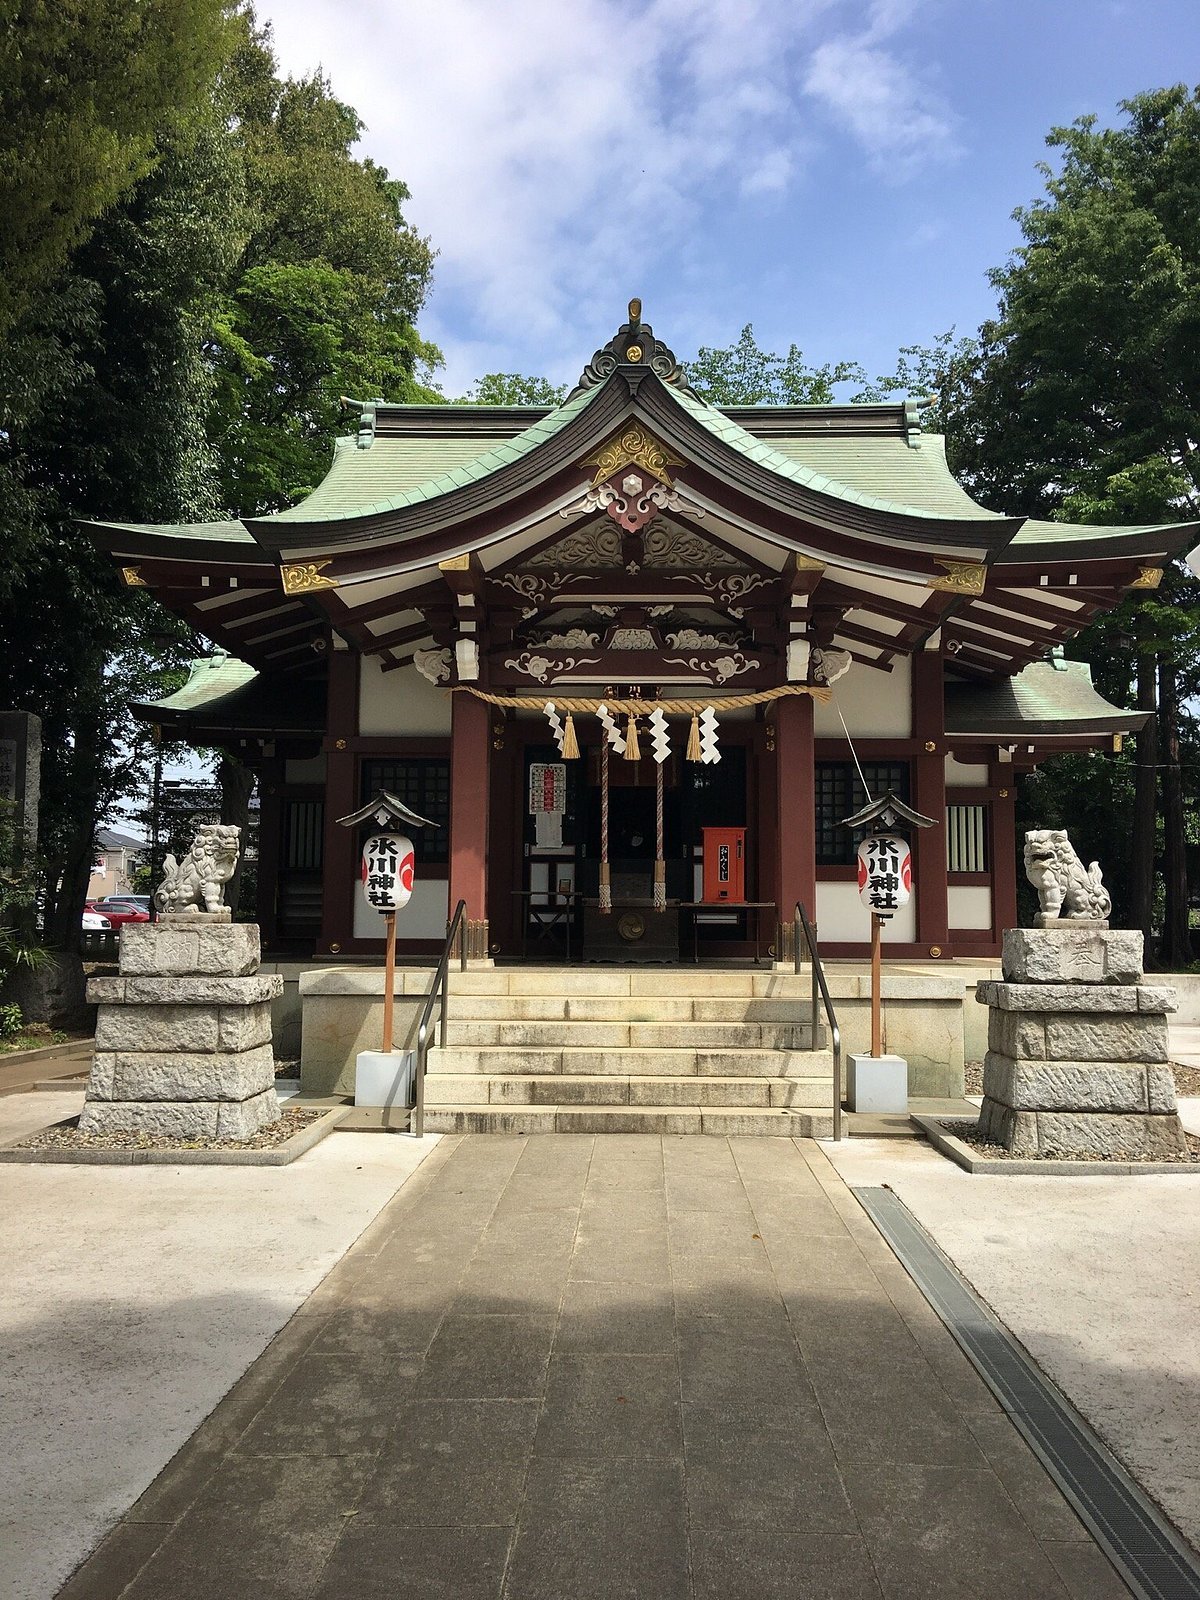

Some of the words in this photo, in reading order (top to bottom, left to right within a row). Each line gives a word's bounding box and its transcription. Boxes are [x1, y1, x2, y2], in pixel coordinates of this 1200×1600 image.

[368, 837, 398, 907] 氷川神社
[720, 846, 728, 881] おみくじ
[866, 838, 899, 909] 氷川神社
